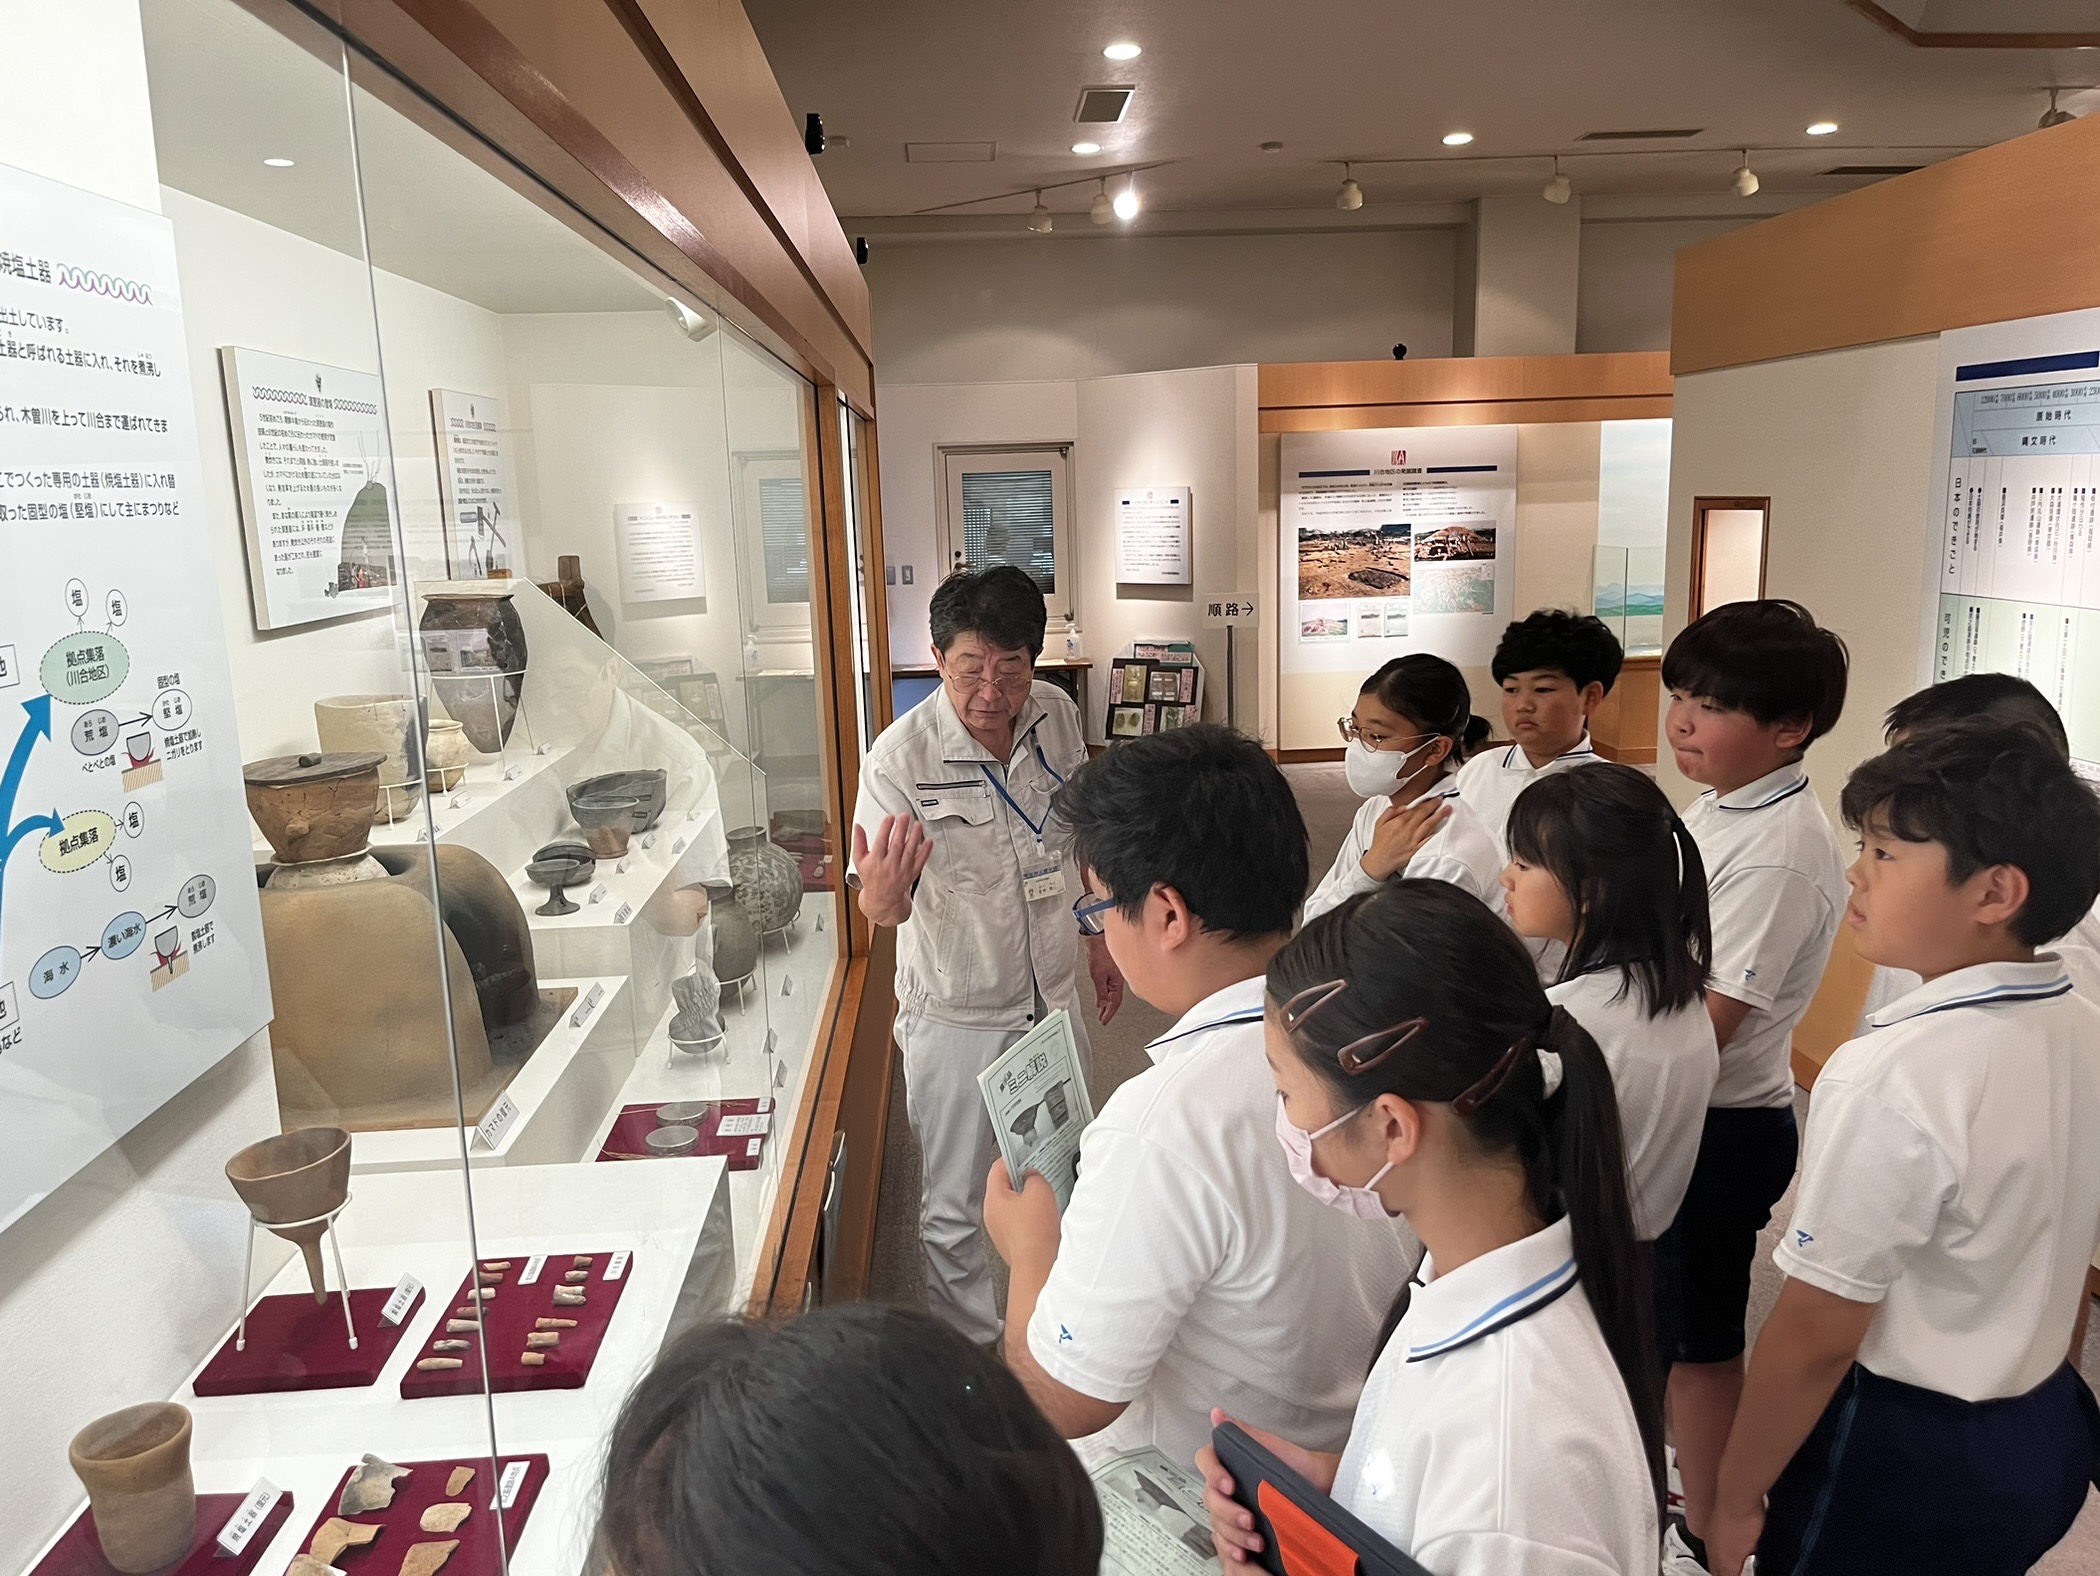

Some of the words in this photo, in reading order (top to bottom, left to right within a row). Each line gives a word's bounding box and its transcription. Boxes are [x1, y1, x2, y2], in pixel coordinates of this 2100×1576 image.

[2036, 409, 2072, 422] 原始時代
[2021, 435, 2057, 447] 縄文時代
[1948, 477, 1961, 574] 日本のできごと
[72, 590, 83, 607] 塩
[112, 600, 122, 616] 塩
[1207, 602, 1239, 617] 順路
[66, 645, 105, 668] 拠点集落
[66, 664, 110, 687] (川合地区)
[84, 725, 109, 743] 荒塩
[129, 811, 140, 829] 塩
[59, 827, 99, 857] 拠点集落
[115, 864, 127, 882] 塩
[43, 961, 70, 985] 海水
[485, 1101, 512, 1138] カマドの復元
